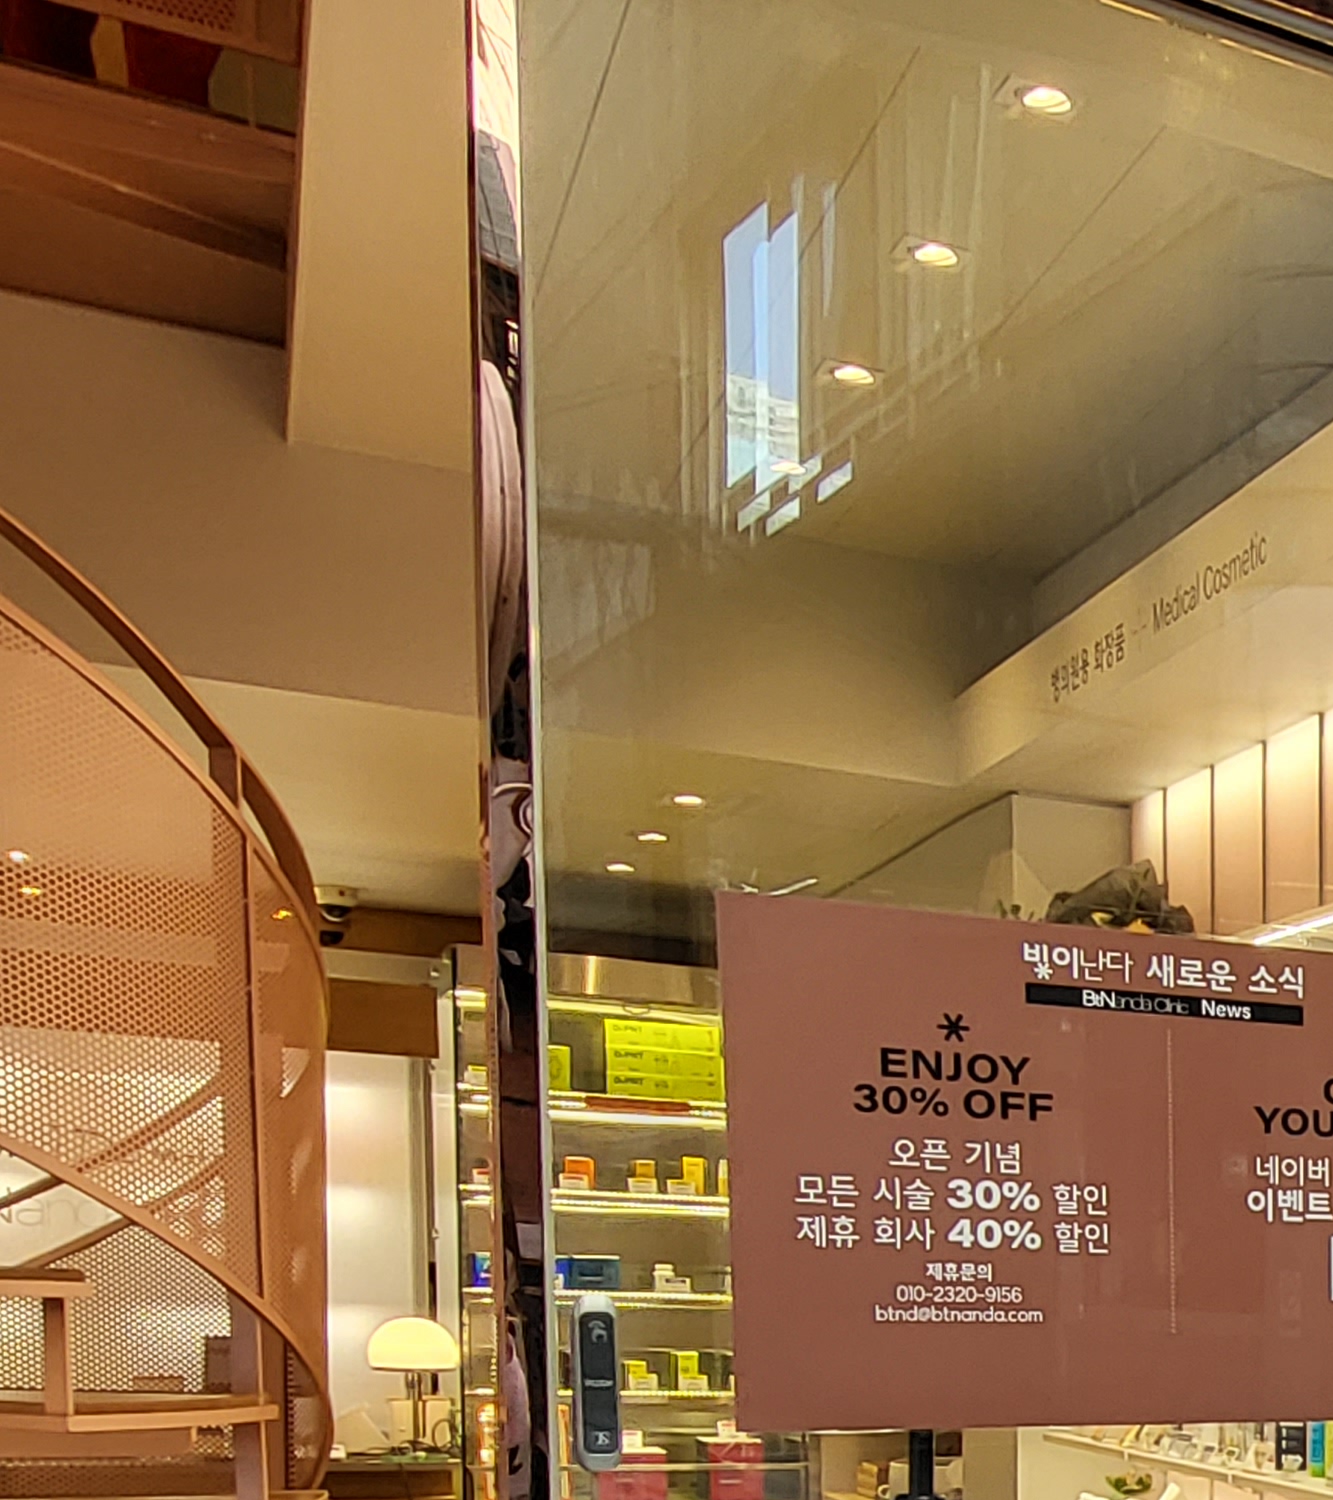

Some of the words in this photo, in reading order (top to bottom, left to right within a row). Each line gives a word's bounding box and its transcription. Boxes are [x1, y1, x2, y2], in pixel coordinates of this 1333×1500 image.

[1152, 572, 1200, 634] Medical
[1202, 531, 1267, 600] Cosmetic
[1094, 622, 1126, 673] 화장품
[1146, 954, 1236, 993] 새로운
[1248, 965, 1304, 999] 소식
[1201, 999, 1251, 1019] News
[879, 1047, 1031, 1085] ENJOY
[853, 1083, 949, 1117] 30%
[962, 1089, 1054, 1121] OFF
[888, 1138, 951, 1172] 오픈
[964, 1140, 1021, 1175] 기념
[1256, 1155, 1330, 1188] 네이버
[794, 1175, 860, 1209] 모든
[873, 1177, 935, 1211] 시술
[947, 1179, 1042, 1212] 30%
[1052, 1183, 1108, 1216] 할인
[1246, 1188, 1333, 1223] 이벤트
[796, 1215, 860, 1249] 제휴
[873, 1217, 936, 1251] 회사
[947, 1218, 1042, 1250] 40%
[1053, 1222, 1110, 1254] 할인
[925, 1262, 993, 1282] 제휴문의
[896, 1285, 1023, 1303] 010-2320-9156
[875, 1304, 1043, 1322] btnd@btnanda.com
